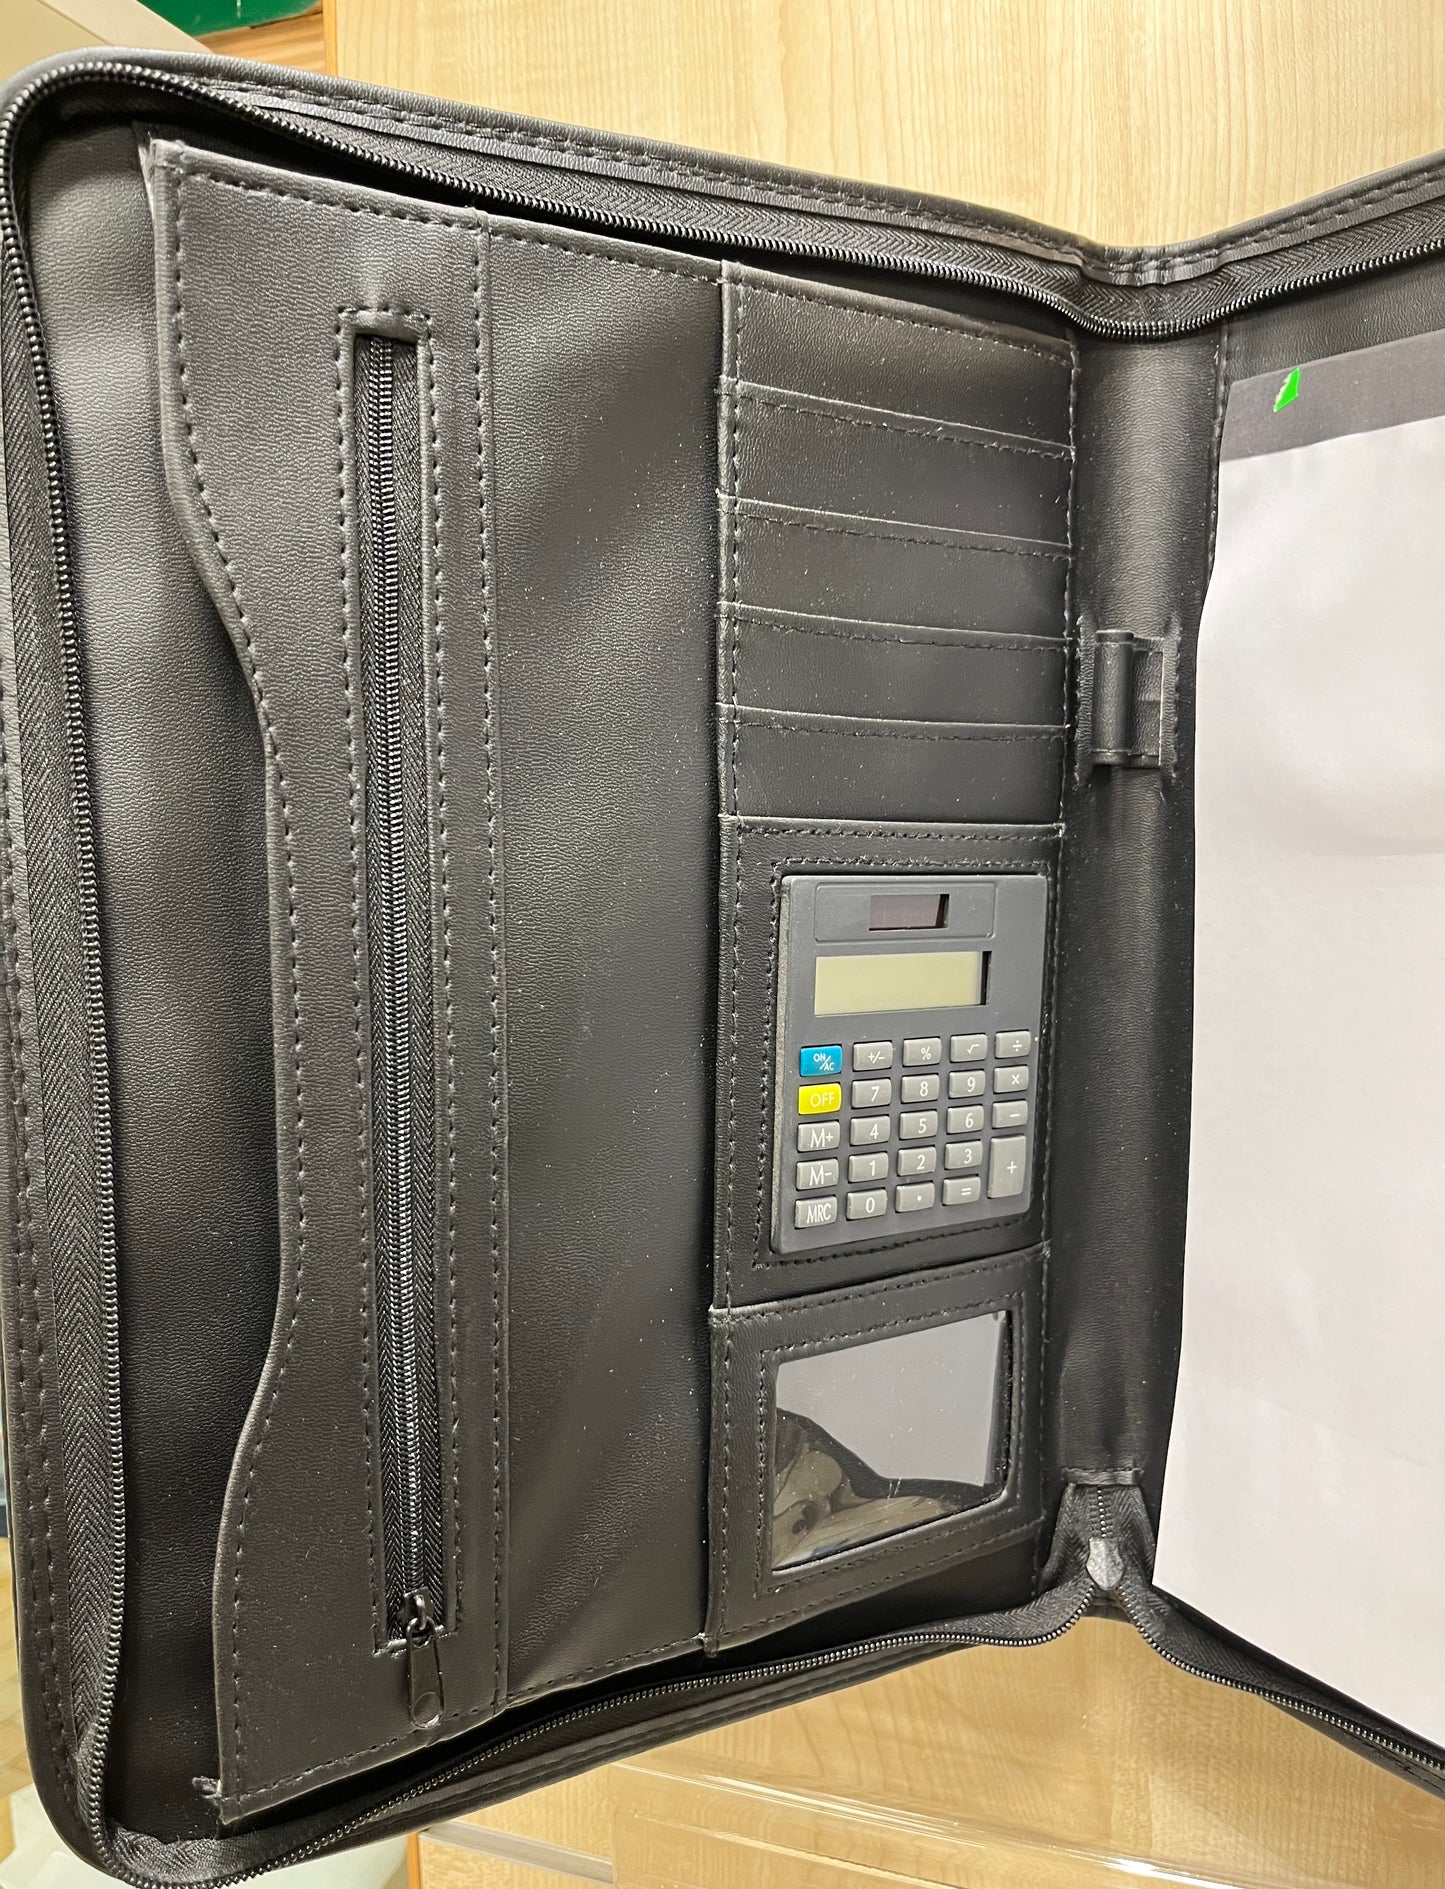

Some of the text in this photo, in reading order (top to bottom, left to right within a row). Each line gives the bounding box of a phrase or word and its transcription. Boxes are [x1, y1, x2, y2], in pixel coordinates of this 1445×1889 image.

[920, 1081, 928, 1096] 8
[967, 1077, 976, 1092] 9
[810, 1092, 835, 1107] OFF
[871, 1086, 880, 1102] 7
[918, 1118, 926, 1133] 5
[965, 1113, 974, 1128] 6
[810, 1128, 833, 1148] M+
[869, 1124, 879, 1139] 4
[916, 1154, 925, 1170] 2
[964, 1148, 972, 1164] 3
[809, 1165, 832, 1186] M-
[869, 1160, 876, 1176] 1
[866, 1197, 875, 1213] 0
[806, 1203, 832, 1224] MRC
